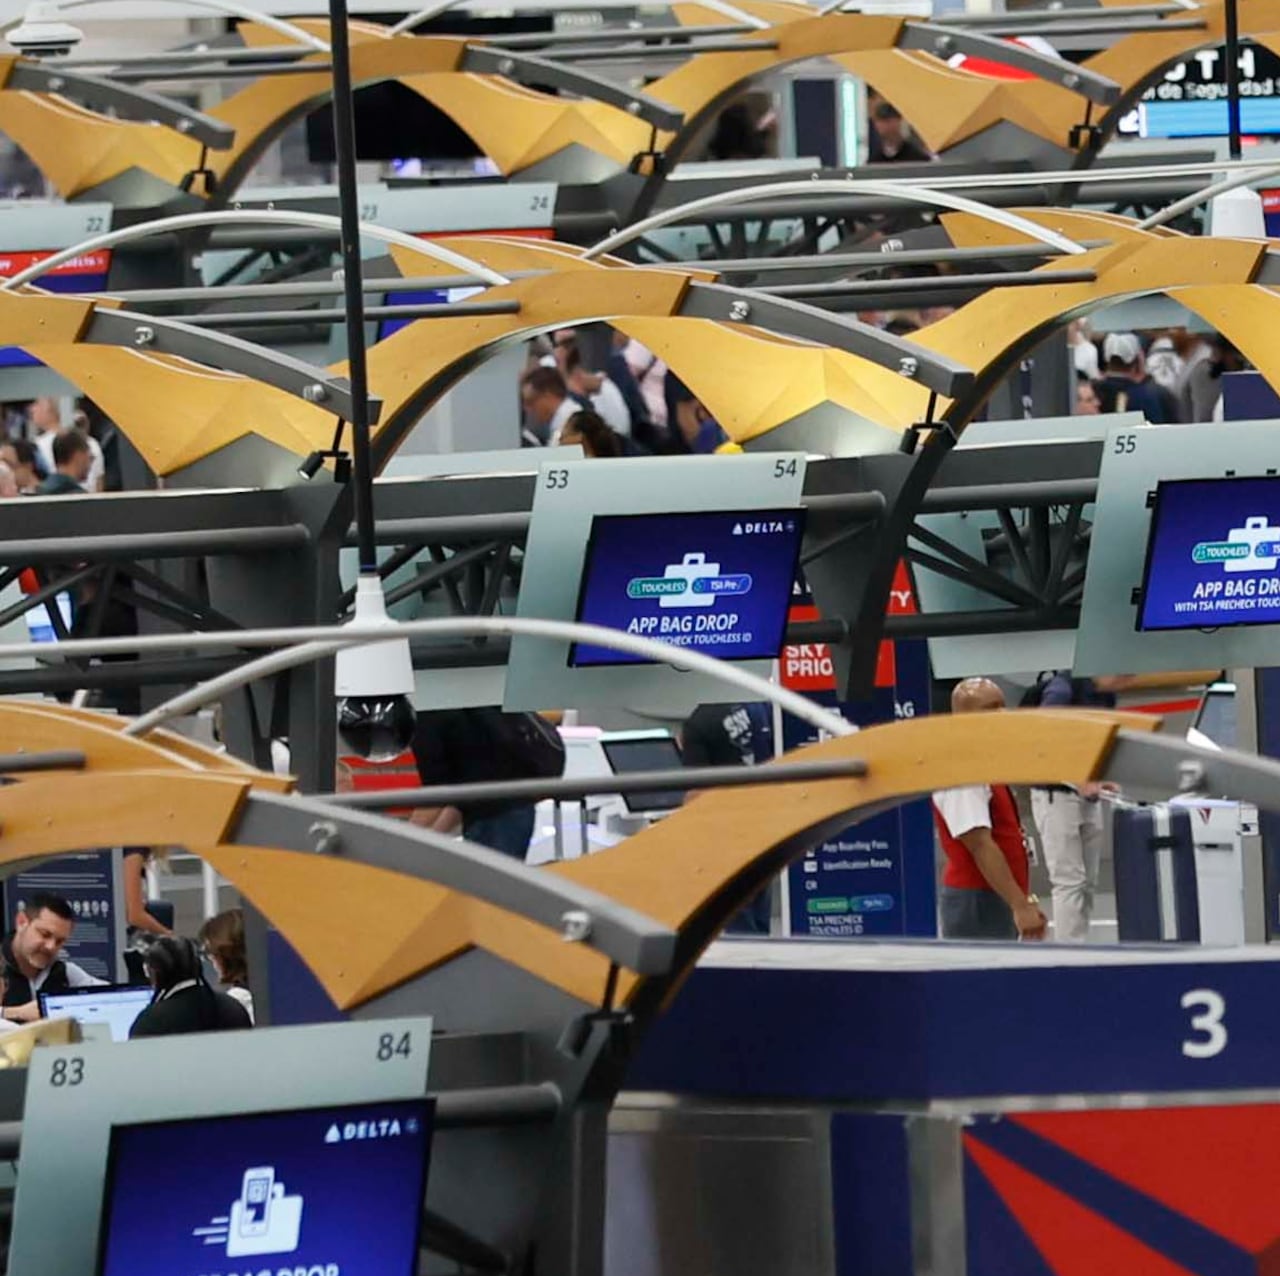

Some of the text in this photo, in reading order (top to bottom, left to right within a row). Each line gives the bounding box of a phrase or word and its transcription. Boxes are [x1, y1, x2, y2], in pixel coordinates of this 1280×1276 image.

[361, 204, 378, 220] 23
[530, 196, 549, 211] 24
[86, 217, 103, 233] 22
[1114, 435, 1136, 454] 55
[774, 459, 797, 478] 54
[546, 470, 568, 489] 53
[745, 521, 783, 534] DELTA
[1206, 545, 1249, 558] TOUCHLESS
[641, 580, 686, 593] TOUCHLESS
[1193, 581, 1222, 598] APP
[1225, 579, 1255, 597] BAG
[1174, 600, 1198, 612] WITH
[1199, 600, 1214, 612] TSA
[1215, 597, 1256, 610] PRECHECK
[628, 613, 738, 634] APP BAG DROP
[693, 633, 742, 645] TOUCHLESS
[742, 632, 752, 643] ID
[1180, 989, 1228, 1059] 3
[376, 1031, 412, 1061] 84
[50, 1058, 85, 1087] 83
[343, 1121, 401, 1141] DELTA
